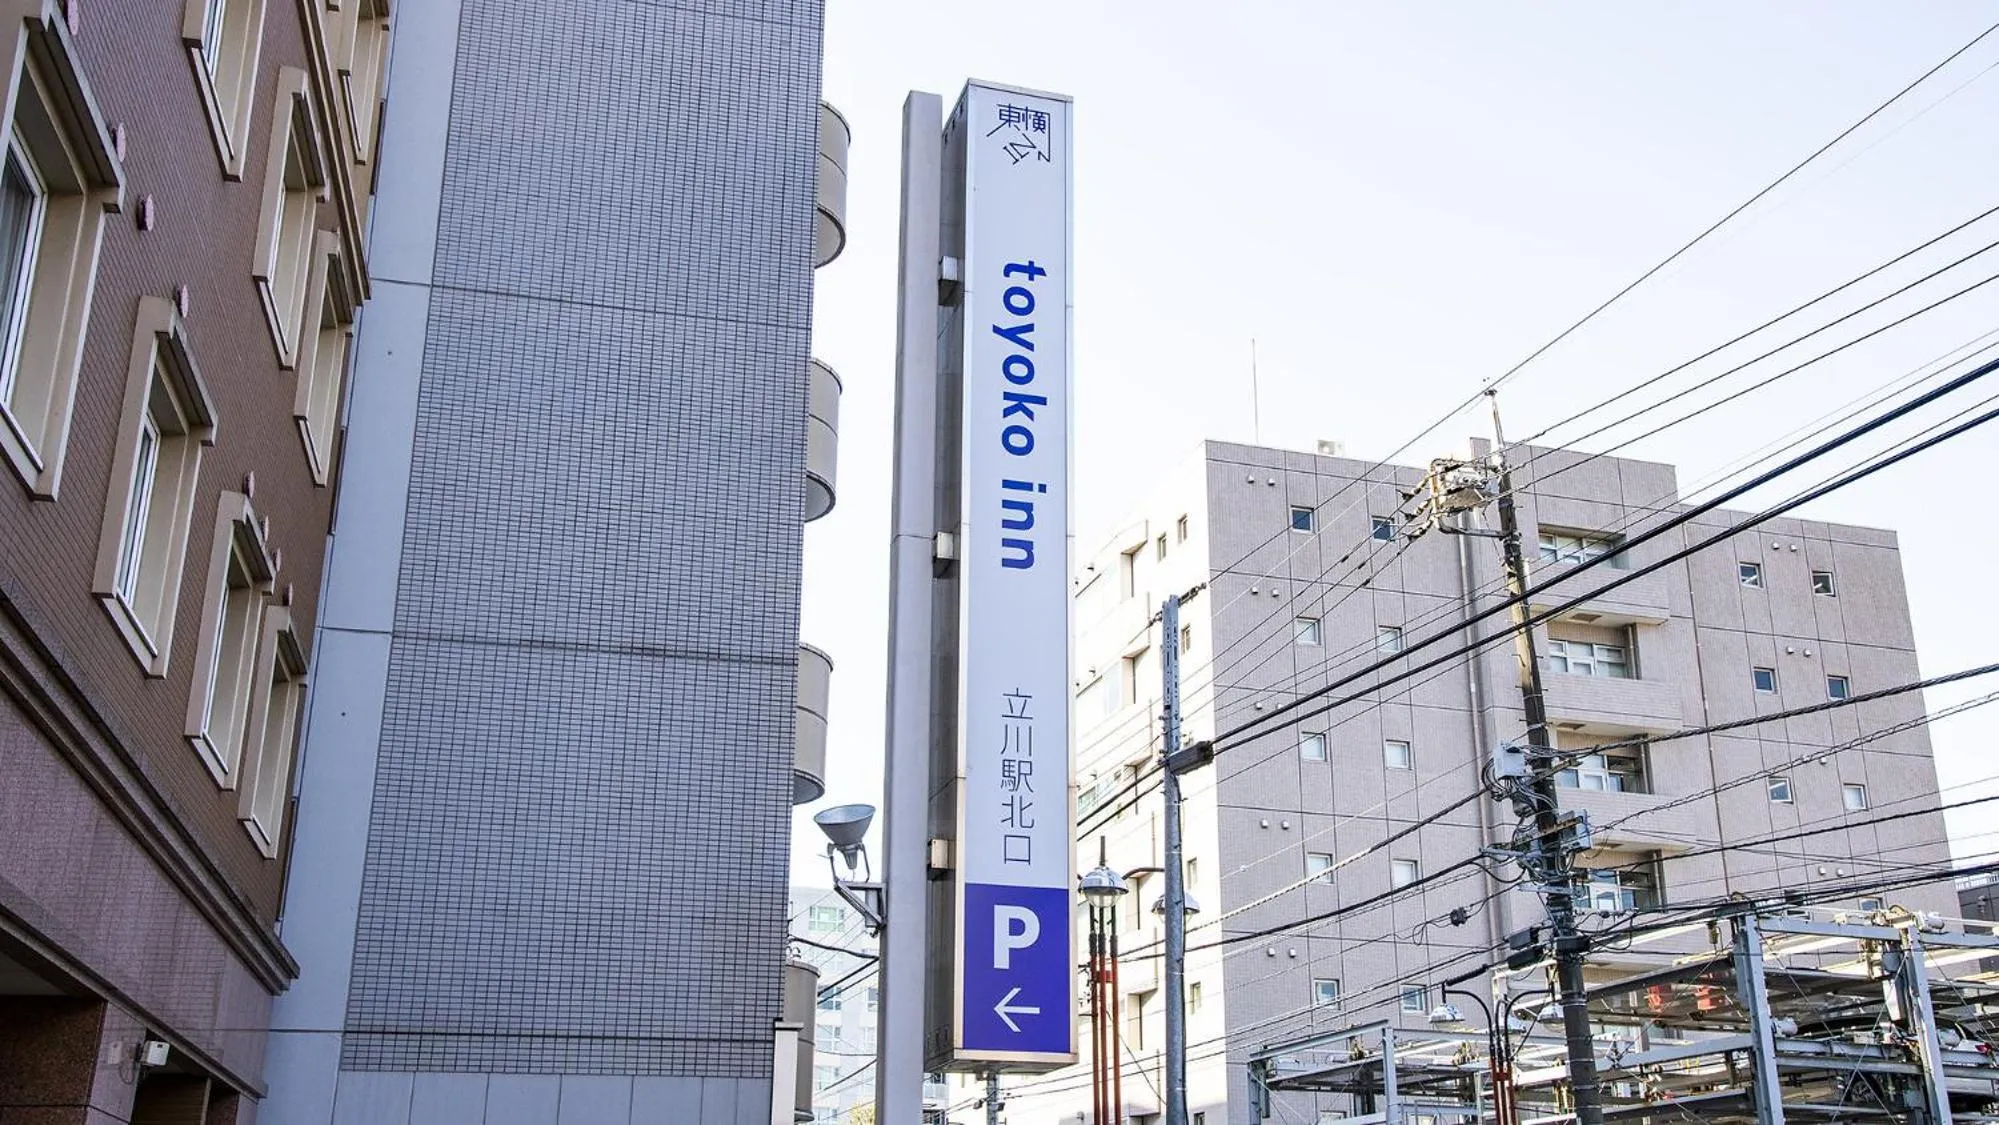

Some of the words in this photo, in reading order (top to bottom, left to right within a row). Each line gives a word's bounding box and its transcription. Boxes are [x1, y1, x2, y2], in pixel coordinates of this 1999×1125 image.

[992, 260, 1048, 457] toyoko
[1001, 479, 1047, 570] inn
[1000, 687, 1035, 866] 立川駅北口
[993, 904, 1041, 970] P
